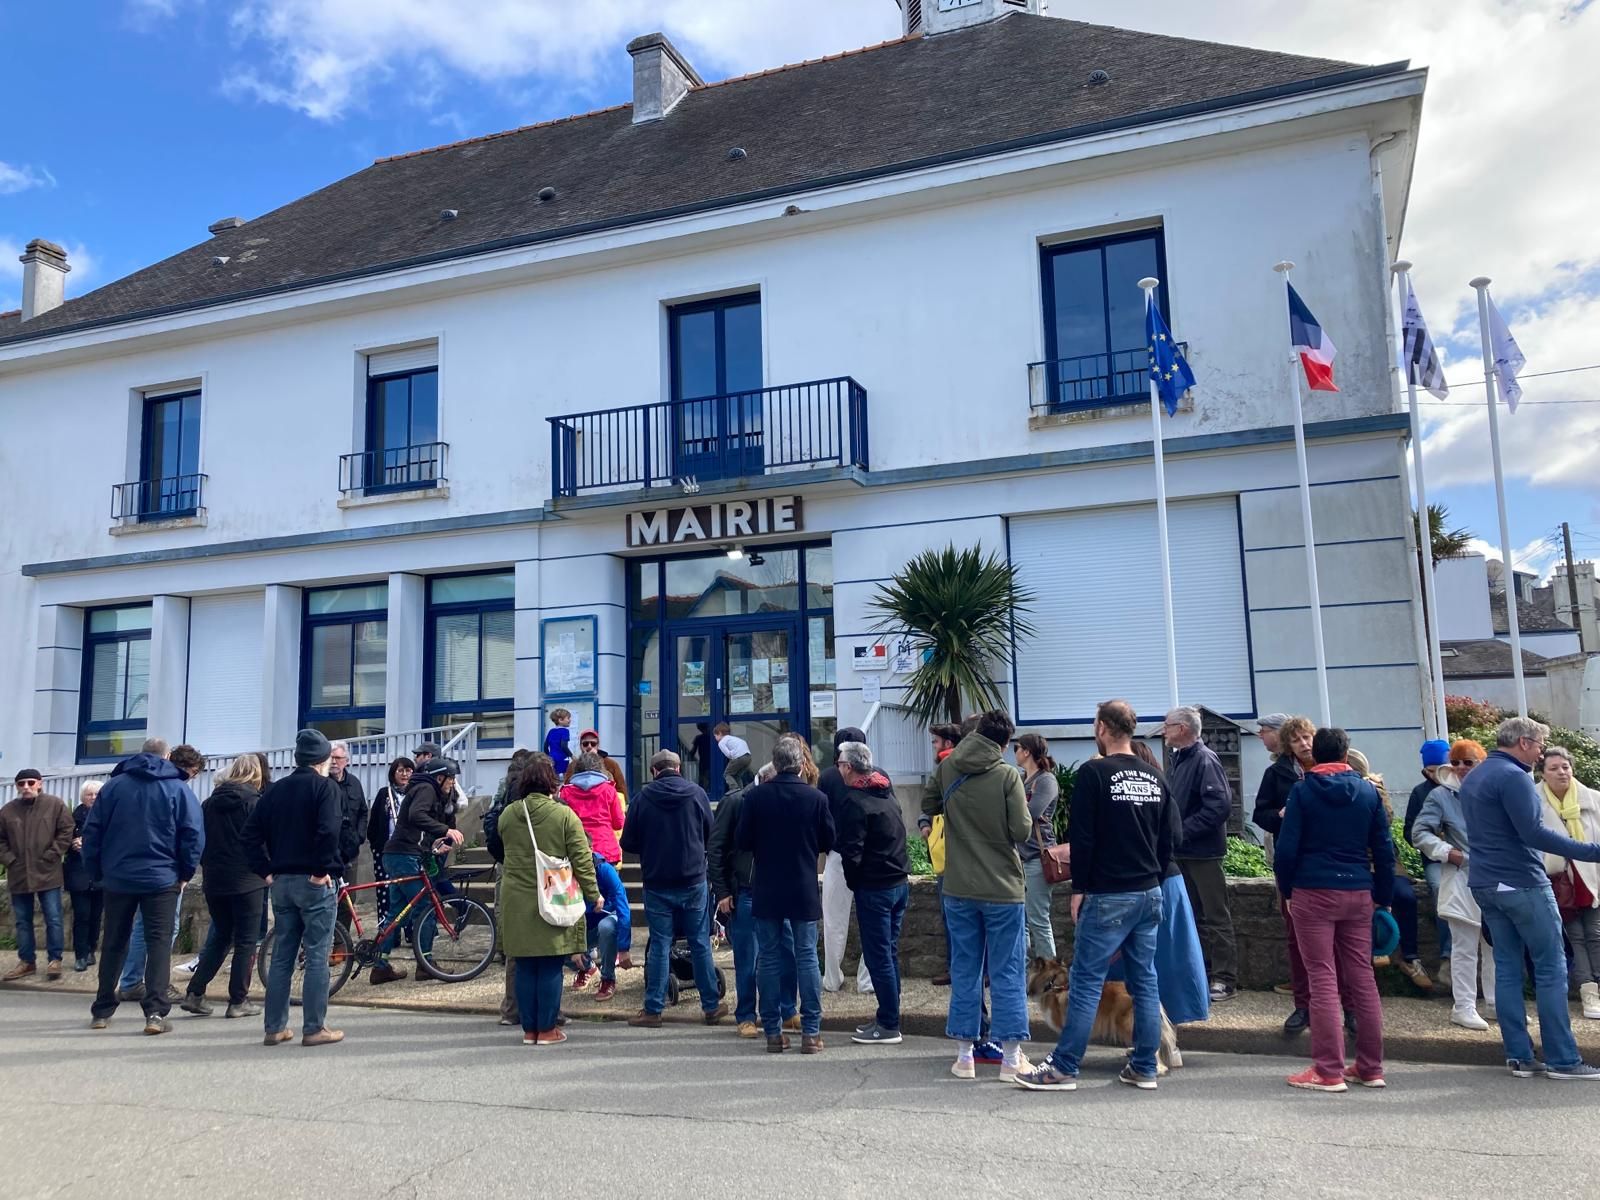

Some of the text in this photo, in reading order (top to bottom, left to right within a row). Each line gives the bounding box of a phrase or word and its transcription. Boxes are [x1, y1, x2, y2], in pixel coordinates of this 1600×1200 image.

[631, 495, 796, 546] MAIRIE
[1111, 771, 1124, 782] OFF
[1139, 771, 1158, 784] WALL
[1125, 782, 1149, 793] VANS
